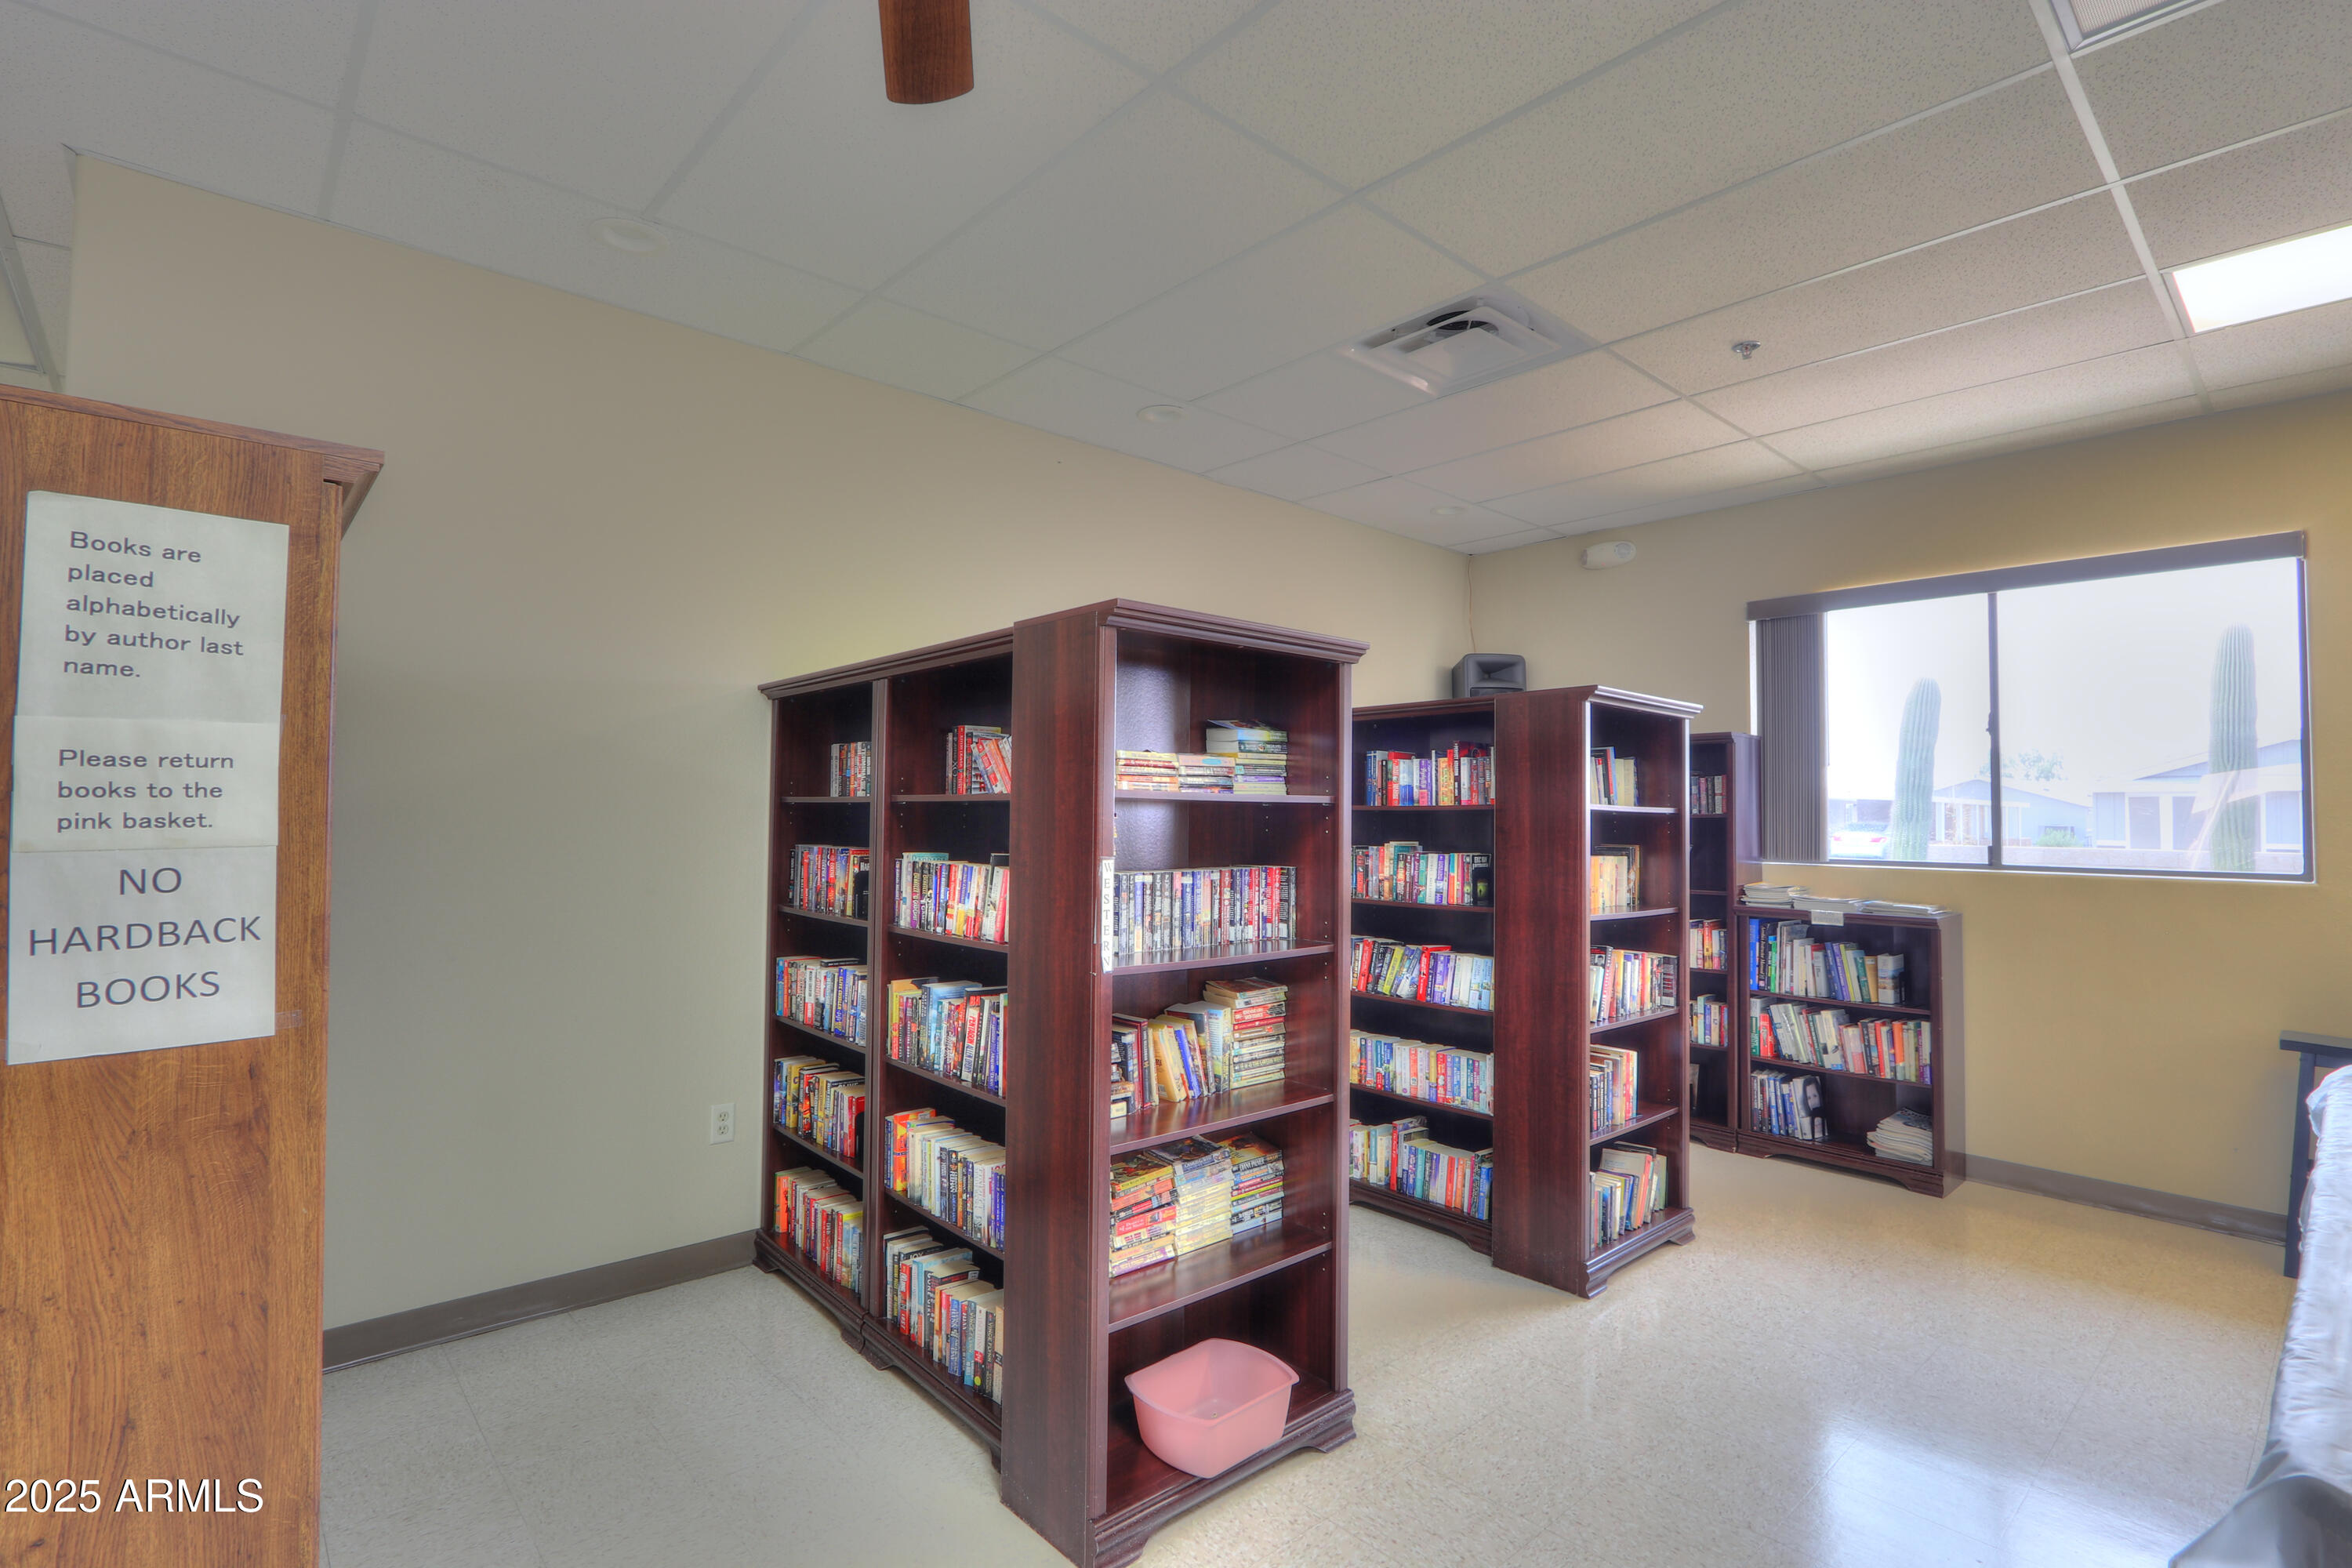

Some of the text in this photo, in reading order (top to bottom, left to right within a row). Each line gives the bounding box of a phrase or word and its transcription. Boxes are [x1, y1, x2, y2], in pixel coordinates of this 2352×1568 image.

[70, 531, 201, 563] Books are
[67, 564, 154, 587] placed
[66, 594, 240, 628] alphabetically
[64, 625, 244, 655] by author last
[64, 660, 140, 677] name.
[59, 750, 234, 769] Please return
[58, 782, 223, 799] books to the
[57, 811, 213, 833] pink basket.
[119, 867, 182, 895] NO
[1103, 862, 1112, 966] WESTERN
[29, 916, 261, 956] HARDBACK
[77, 971, 220, 1008] BOOKS
[966, 1016, 977, 1045] PENTAGON
[965, 1045, 974, 1058] ALLEN
